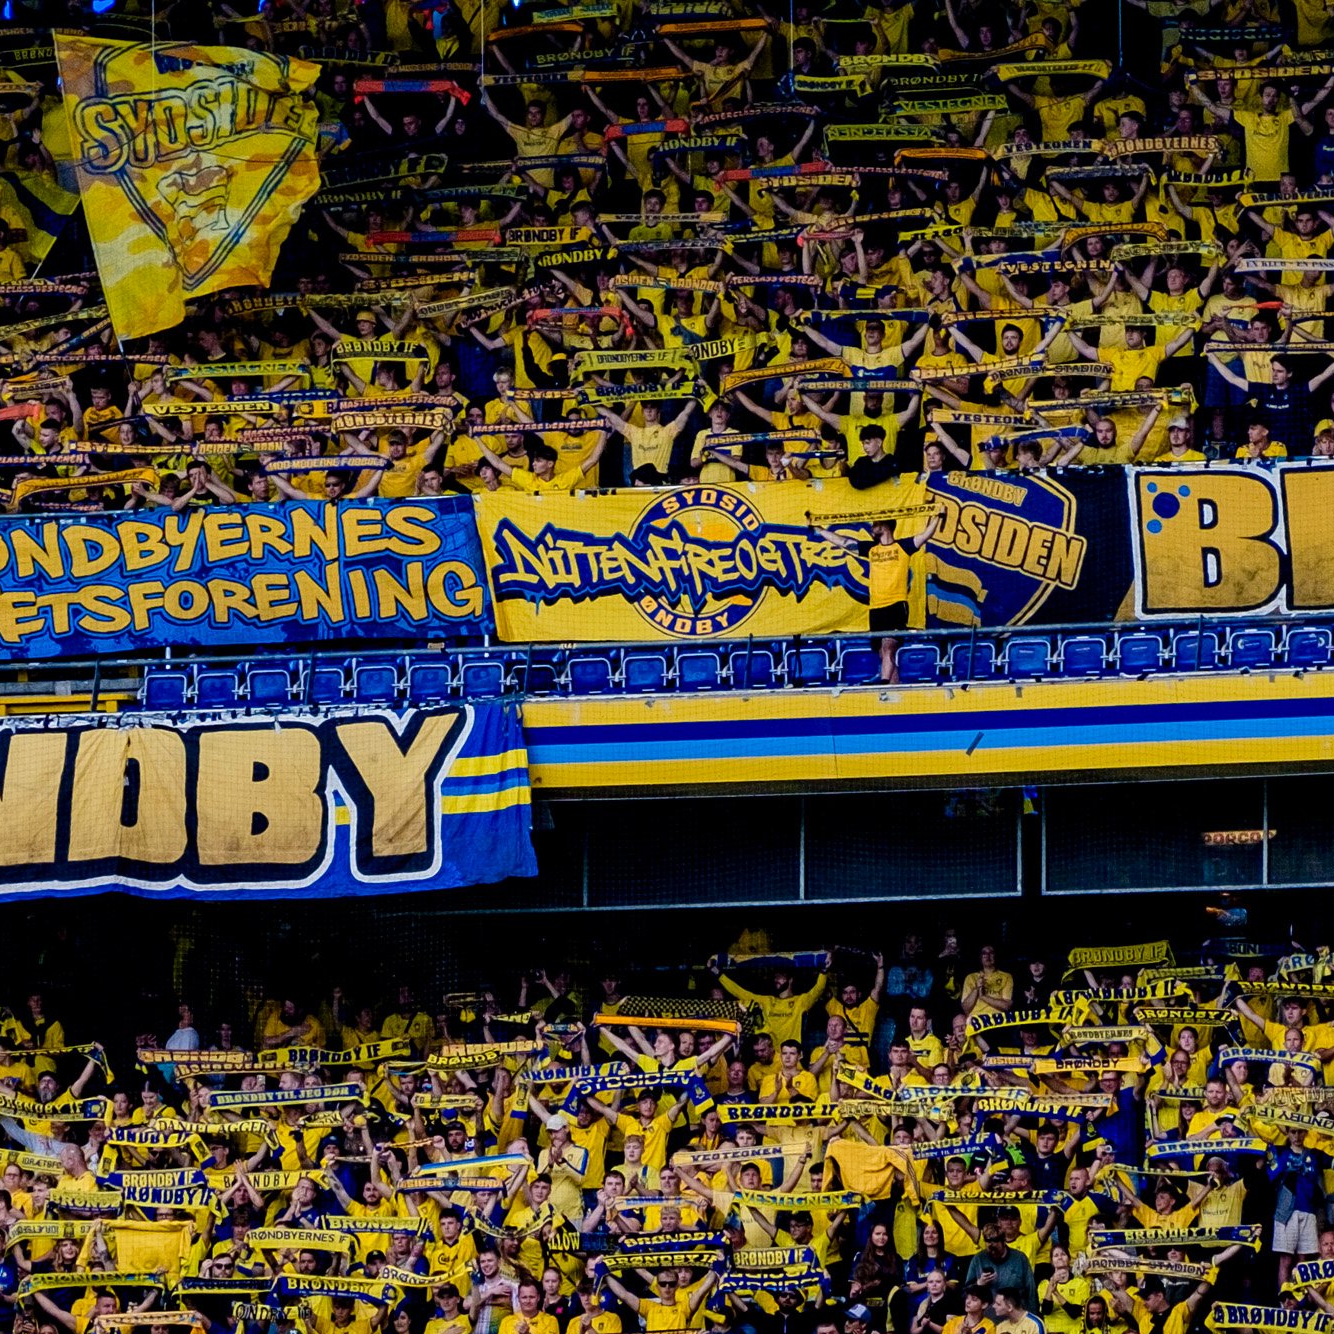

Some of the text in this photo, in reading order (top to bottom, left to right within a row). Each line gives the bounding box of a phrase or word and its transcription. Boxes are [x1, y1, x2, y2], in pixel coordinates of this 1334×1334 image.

[662, 488, 760, 530] SYDSID
[927, 504, 1085, 587] DSIDEN
[640, 599, 730, 636] ØNDBY
[216, 1088, 349, 1105] BRØNDBY TIL JEG DØR
